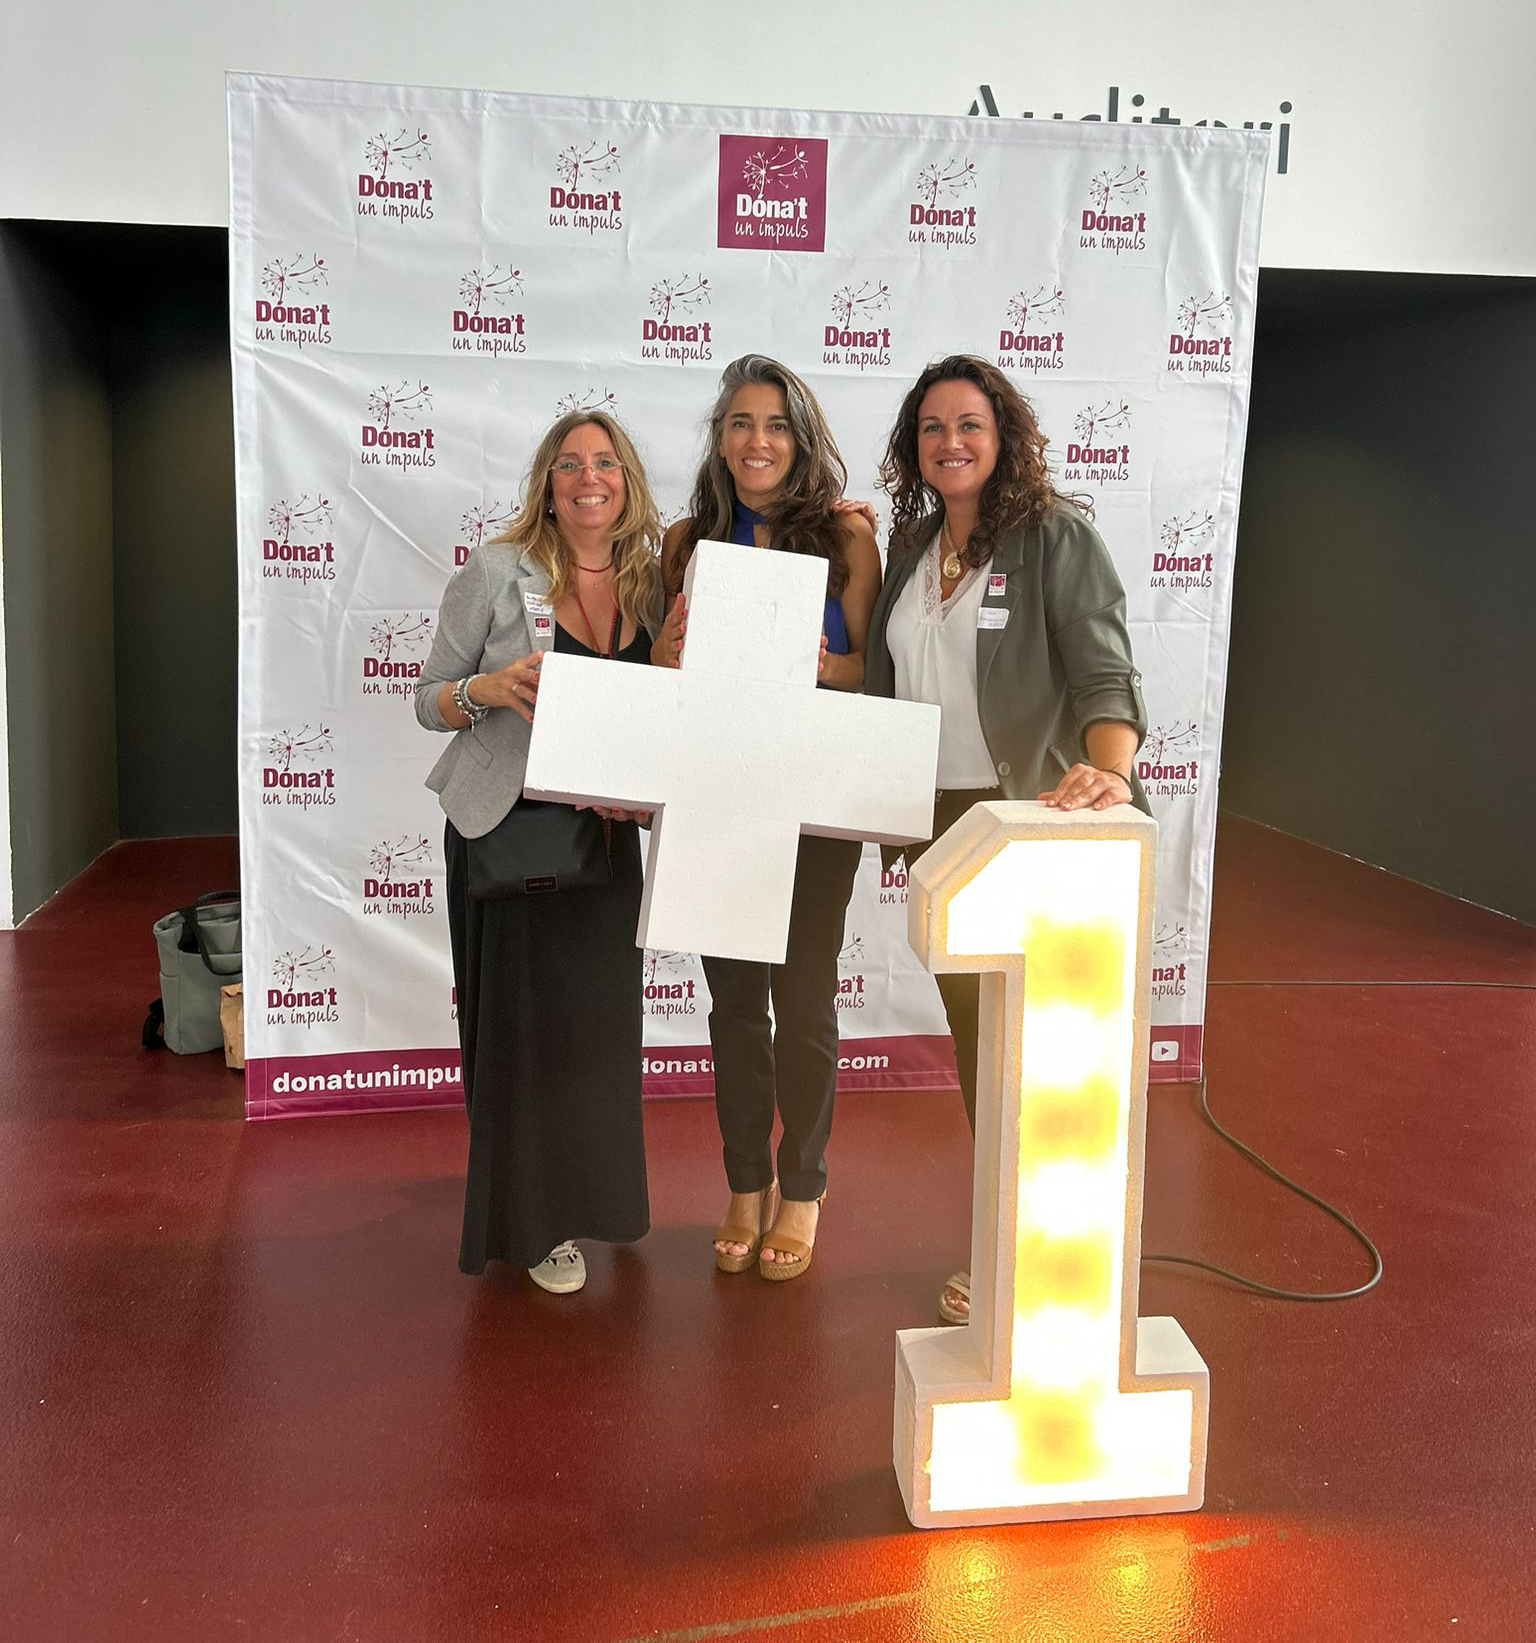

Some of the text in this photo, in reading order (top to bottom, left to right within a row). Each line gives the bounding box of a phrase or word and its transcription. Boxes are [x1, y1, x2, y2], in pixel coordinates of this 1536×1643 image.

[359, 174, 432, 200] Dóna't
[550, 186, 621, 211] Dóna't
[737, 194, 807, 219] Dóna't
[358, 202, 377, 216] un
[910, 204, 976, 227] Dóna't
[550, 214, 568, 227] un
[736, 222, 754, 235] un
[1082, 210, 1146, 232] Dóna't
[909, 230, 926, 243] un
[1080, 236, 1097, 248] un
[256, 300, 330, 325] Dóna't
[453, 311, 525, 334] Dóna't
[643, 319, 711, 342] Dóna't
[256, 327, 275, 341] un
[825, 326, 890, 349] Dóna't
[1000, 330, 1064, 352] Dóna't
[453, 337, 472, 350] un
[642, 346, 660, 358] un
[1169, 334, 1232, 356] Dóna't
[823, 352, 841, 364] un
[997, 356, 1015, 370] un
[1168, 360, 1184, 371] un
[362, 426, 434, 448] Dóna't
[361, 452, 380, 464] un
[1067, 444, 1129, 464] Dóna't
[1065, 469, 1082, 480] un
[263, 540, 334, 562] Dóna't
[263, 565, 282, 578] un
[1153, 553, 1213, 572] Dóna't
[1151, 577, 1166, 587] un
[364, 657, 424, 678] Dóna'
[363, 682, 381, 694] un
[263, 768, 334, 788] Dóna't
[1138, 761, 1198, 779] Dóna't
[263, 793, 281, 804] un
[1145, 784, 1152, 795] n
[364, 878, 433, 898] Dóna't
[880, 893, 896, 904] un
[364, 903, 382, 914] un
[1152, 963, 1186, 981] na't
[268, 988, 337, 1008] Dóna't
[644, 980, 695, 999] óna't
[267, 1013, 286, 1025] un
[838, 1055, 889, 1069] com
[272, 1063, 461, 1093] donatunimpu
